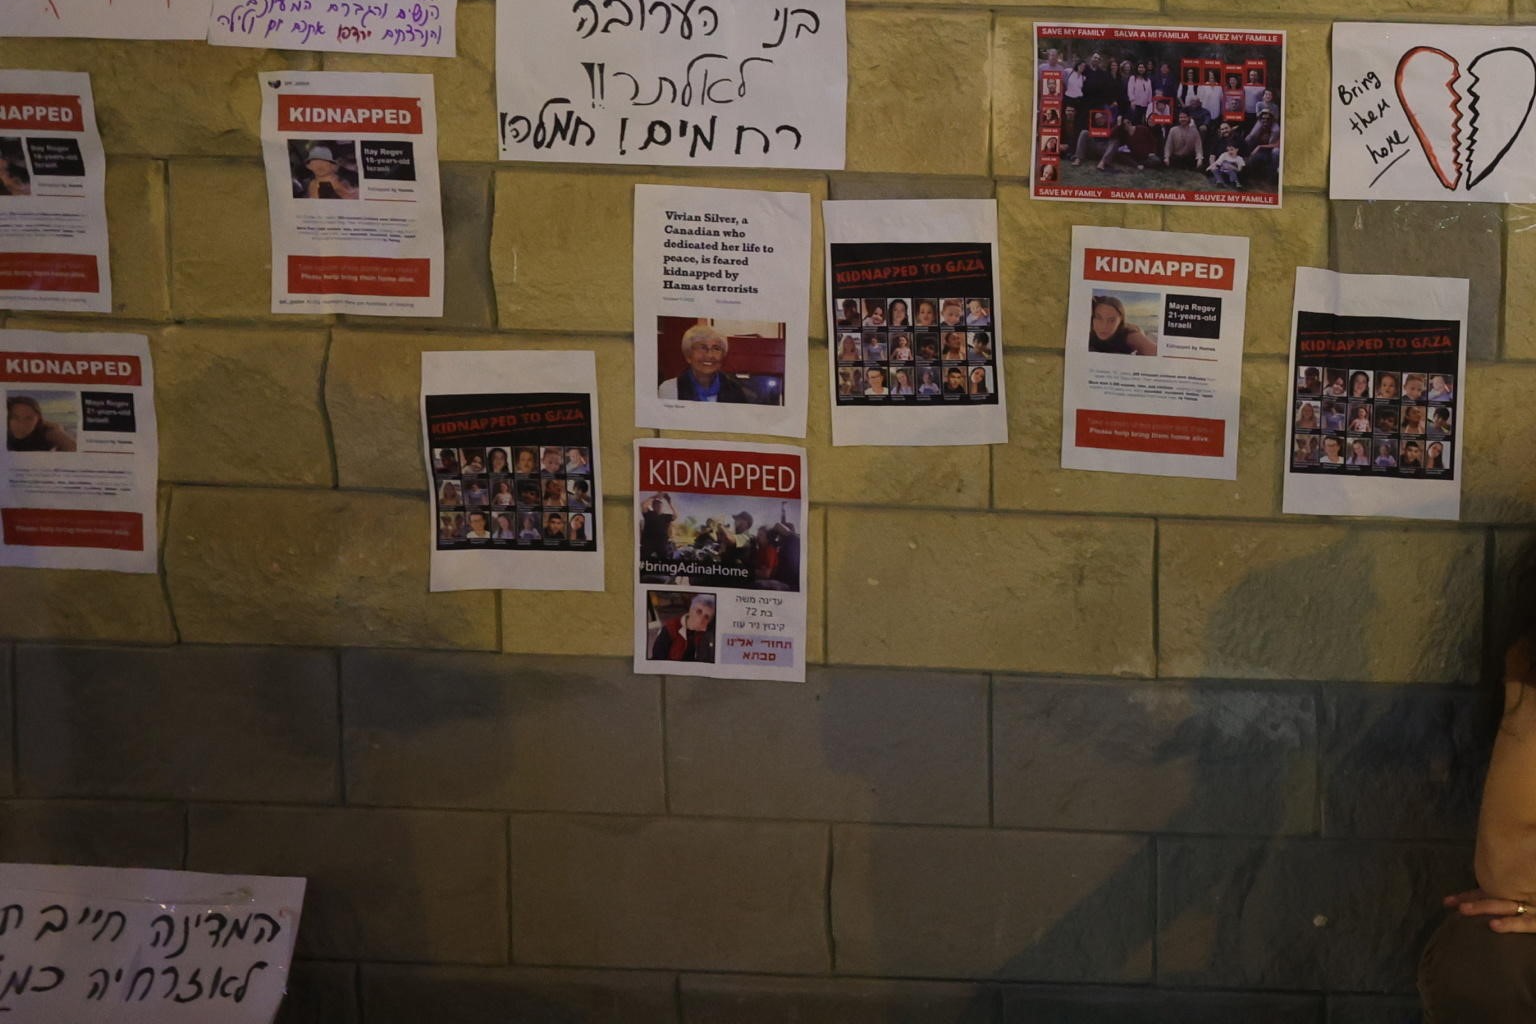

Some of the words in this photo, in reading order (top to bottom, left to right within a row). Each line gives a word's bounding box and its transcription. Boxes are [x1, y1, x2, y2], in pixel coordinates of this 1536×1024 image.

[763, 8, 820, 48] בני
[1042, 28, 1062, 36] SAVE
[1063, 28, 1076, 36] MY
[1077, 29, 1106, 37] FAMILY
[1338, 72, 1381, 105] Bring
[289, 107, 412, 125] KIDNAPPED
[665, 211, 701, 223] Vivian
[704, 213, 739, 225] Silver,
[664, 226, 720, 237] Canadian
[723, 228, 745, 238] who
[664, 239, 718, 251] dedicated
[721, 242, 739, 252] her
[742, 243, 760, 253] life
[763, 245, 774, 253] to
[663, 255, 699, 265] peace,
[701, 255, 711, 264] is
[713, 256, 749, 266] feared
[1095, 256, 1224, 280] KIDNAPPED
[663, 266, 722, 280] kidnapped
[725, 270, 739, 281] by
[663, 281, 704, 291] Hamas
[706, 284, 758, 294] terrorists
[6, 358, 132, 377] KIDNAPPED
[650, 459, 795, 493] KIDNAPPED
[150, 912, 281, 959] המדינה
